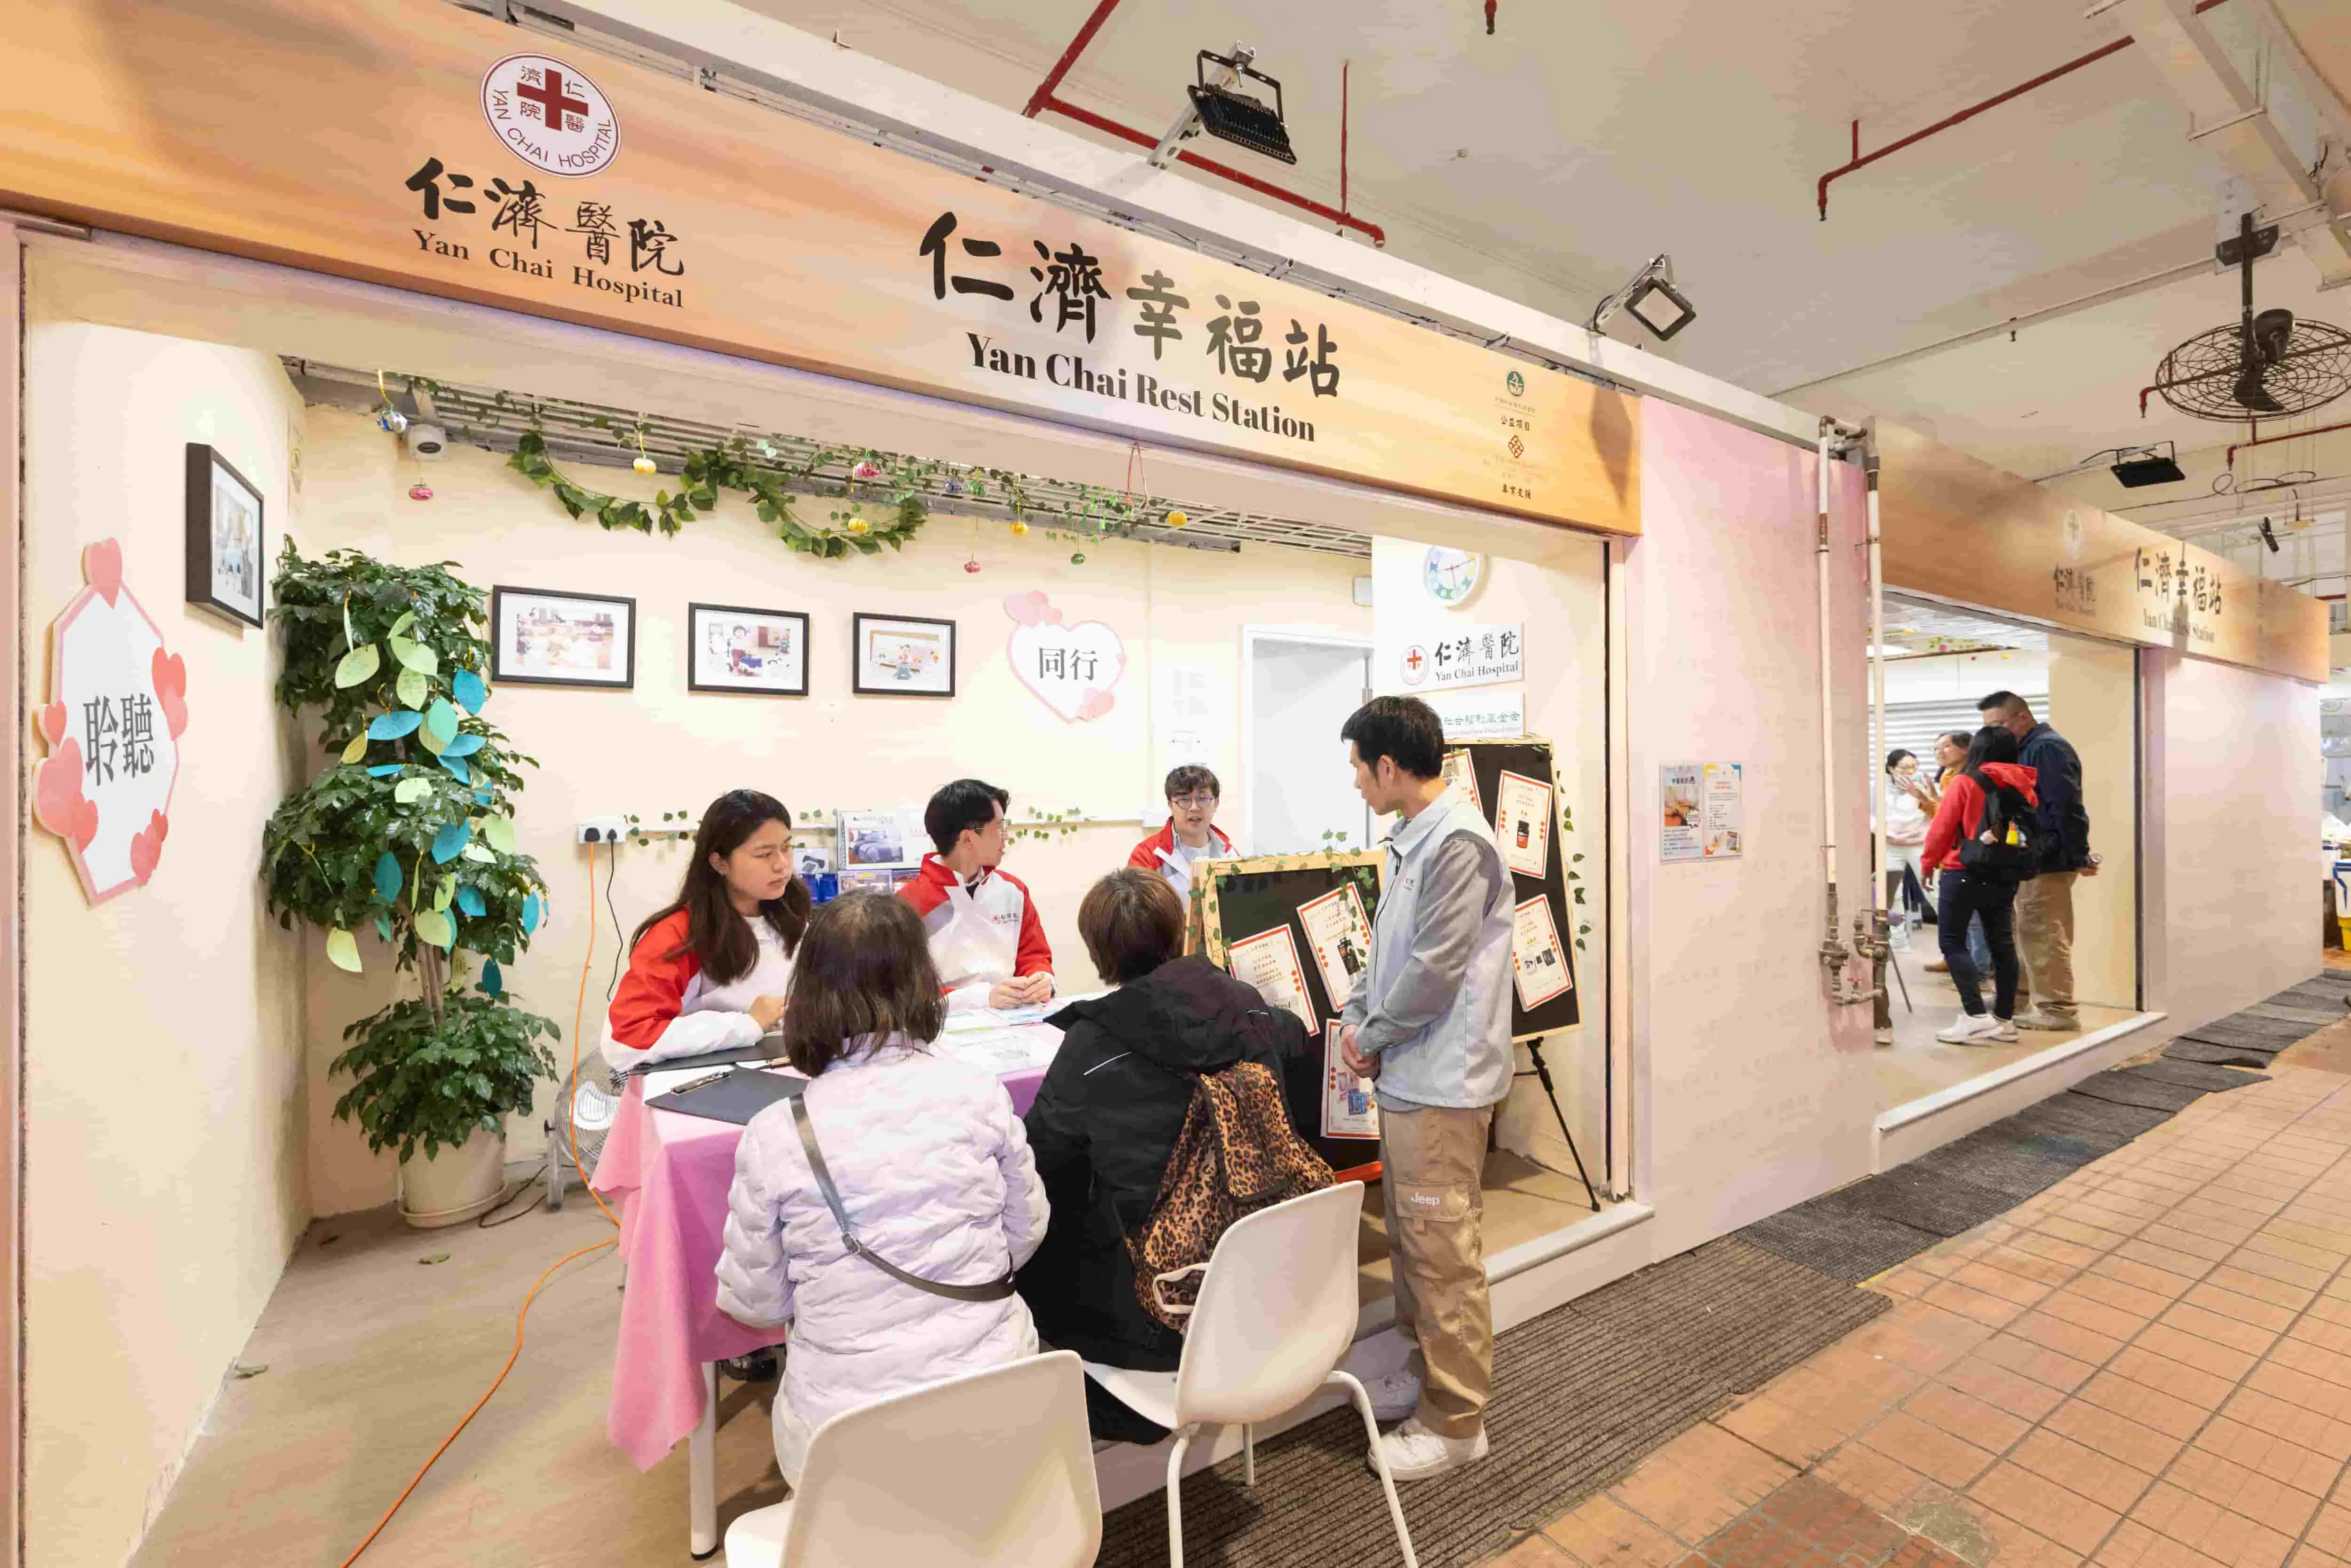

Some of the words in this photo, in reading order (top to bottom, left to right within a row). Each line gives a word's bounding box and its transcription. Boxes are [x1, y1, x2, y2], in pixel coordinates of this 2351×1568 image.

[492, 89, 512, 119] YAN
[507, 127, 548, 162] CHAI
[558, 119, 612, 168] HOSPITAL
[405, 158, 685, 276] 仁濟醫院
[412, 229, 469, 260] Yan
[489, 248, 553, 279] Chai
[572, 266, 684, 308] Hospital
[919, 211, 1341, 399] 仁濟幸福站
[965, 332, 1037, 380] Yan
[1046, 353, 1127, 400] Chai
[1136, 372, 1207, 418] Rest
[1212, 393, 1315, 442] Station
[1038, 647, 1098, 681] 同行
[1435, 630, 1519, 666] 仁濟醫院
[1435, 671, 1452, 681] Yan
[1454, 667, 1475, 679] Chai
[1478, 661, 1519, 677] Hospital
[82, 693, 154, 786] 聆聽
[1411, 1192, 1441, 1207] Jeep
